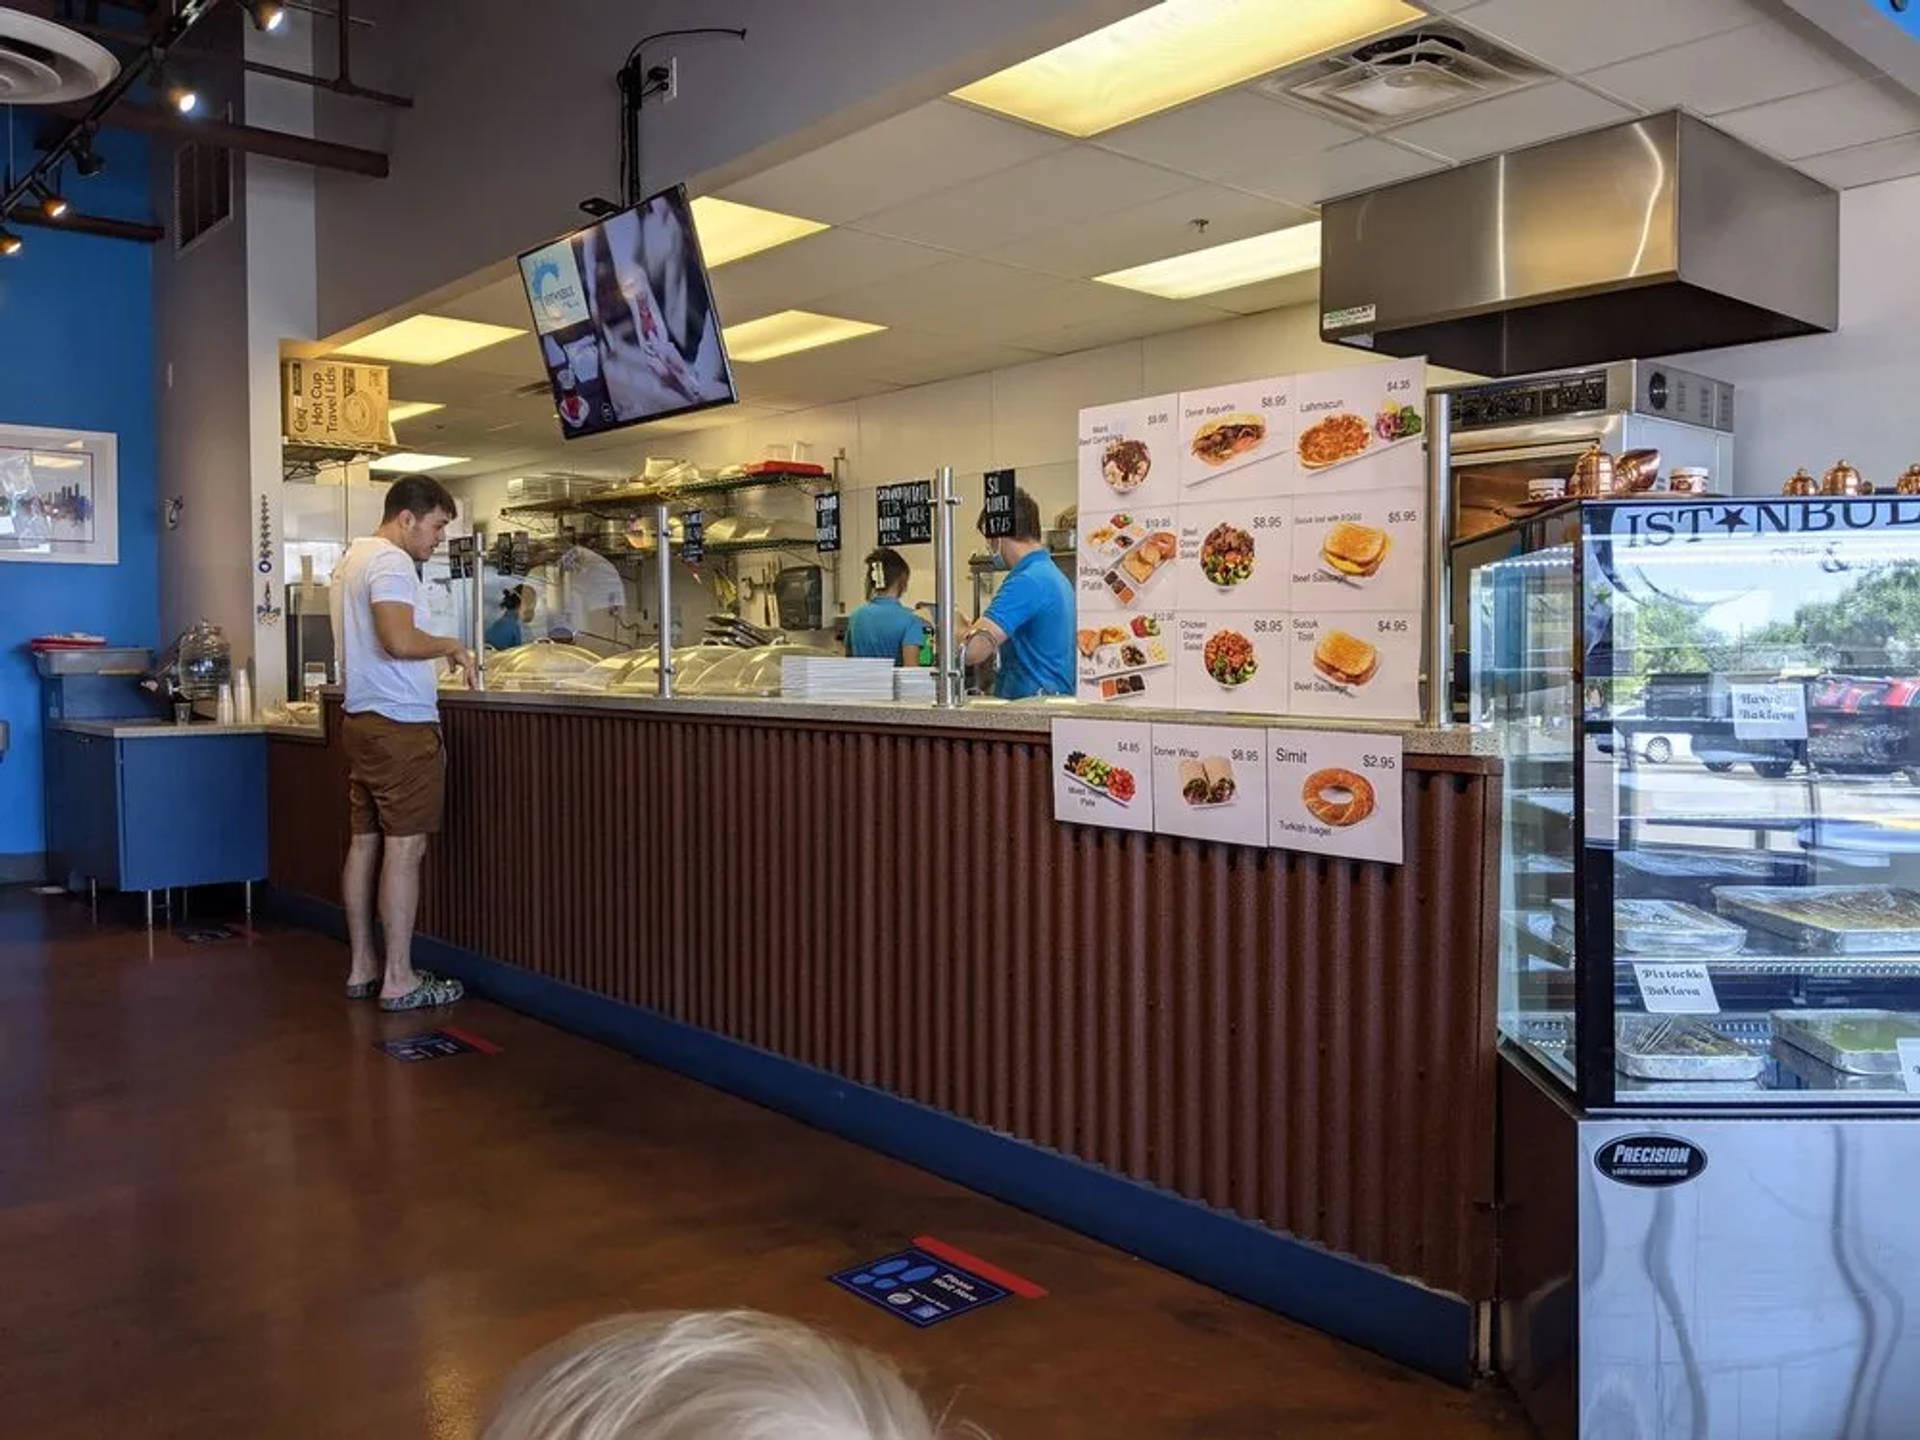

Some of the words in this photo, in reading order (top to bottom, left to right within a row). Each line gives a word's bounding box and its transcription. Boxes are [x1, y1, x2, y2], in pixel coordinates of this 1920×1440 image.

[311, 372, 324, 399] Cup
[325, 366, 336, 393] Lids
[312, 402, 322, 426] Hot
[326, 395, 337, 433] Travel
[1276, 747, 1307, 764] Simit
[1362, 754, 1396, 769] $2.95
[1613, 1144, 1690, 1163] PRECISION
